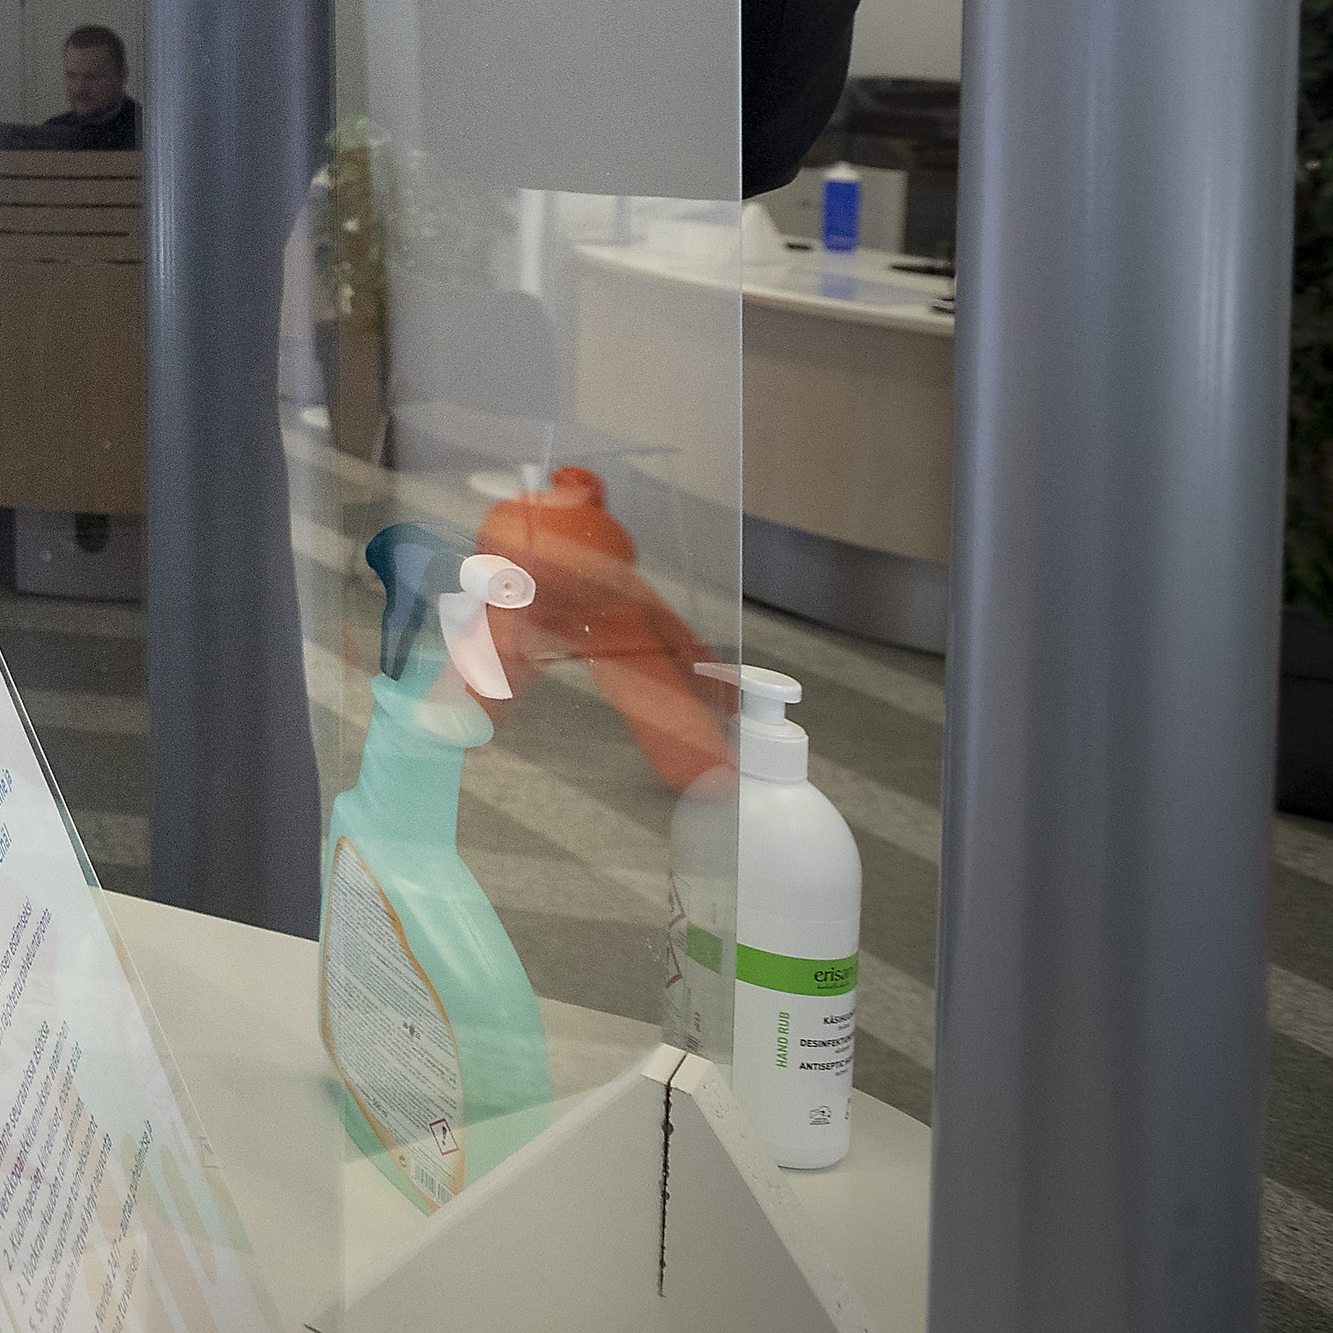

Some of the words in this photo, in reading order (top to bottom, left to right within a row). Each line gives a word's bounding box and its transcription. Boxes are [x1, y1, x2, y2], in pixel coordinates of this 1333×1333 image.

[2, 768, 14, 793] ja
[778, 1011, 789, 1035] RUB
[776, 1036, 788, 1067] HAND
